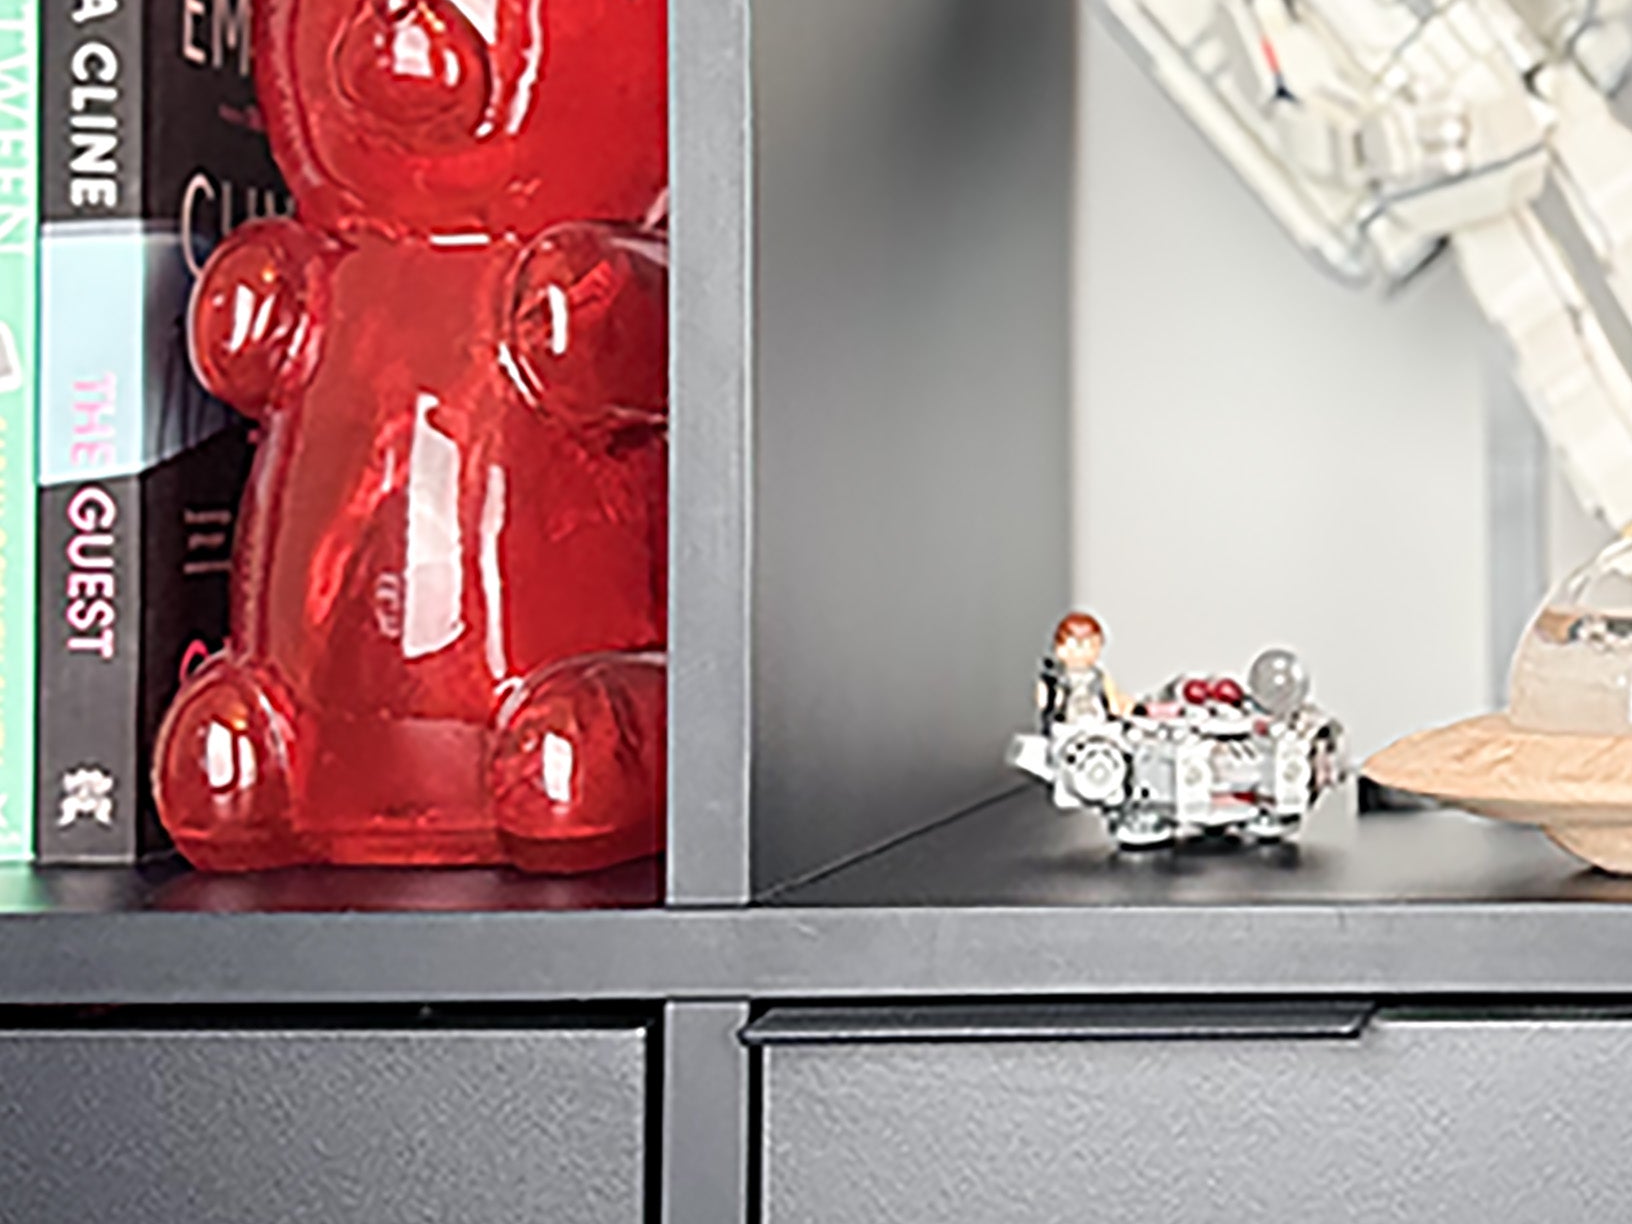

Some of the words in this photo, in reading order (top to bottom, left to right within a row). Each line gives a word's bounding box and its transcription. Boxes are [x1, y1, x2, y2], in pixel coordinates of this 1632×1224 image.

[69, 42, 118, 208] CLINE
[70, 372, 117, 470] THE
[66, 487, 116, 659] GUEST
